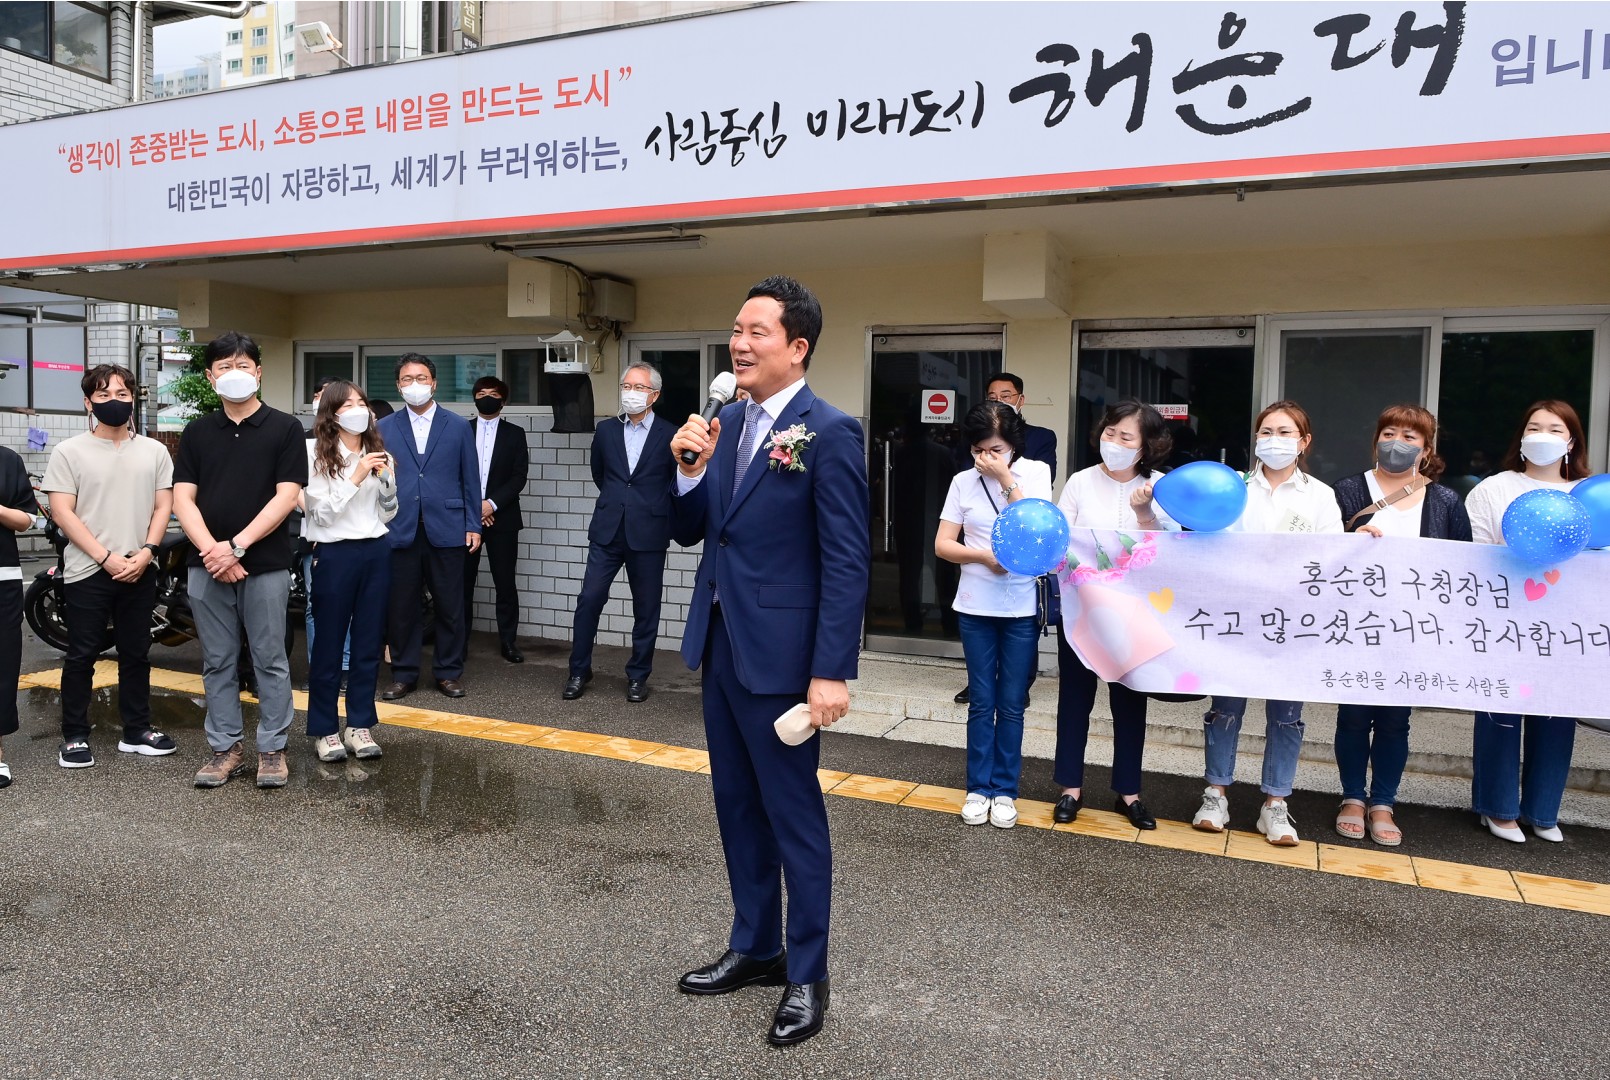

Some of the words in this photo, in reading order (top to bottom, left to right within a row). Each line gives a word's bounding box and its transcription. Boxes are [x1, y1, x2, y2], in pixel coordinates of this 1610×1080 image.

[58, 141, 121, 174] “생각이
[129, 128, 209, 167] 존중받는
[216, 119, 265, 152] 도시,
[273, 106, 367, 145] 소통으로
[375, 93, 451, 133] 내일을
[461, 82, 544, 124] 만드는
[553, 66, 633, 109] 도시”
[168, 173, 271, 213] 대한민국이
[280, 163, 380, 202] 자랑하고,
[390, 150, 468, 190] 세계가
[477, 136, 628, 183] 부러워하는,
[644, 101, 788, 168] 사람중심
[806, 80, 986, 142] 미래도시
[1008, 1, 1468, 137] 해운대
[1491, 28, 1610, 88] 입니
[1299, 561, 1387, 598] 홍순헌
[1401, 569, 1510, 609] 구청장님
[1184, 607, 1245, 641] 수고
[1260, 607, 1455, 647] 많으셨습니다.
[1464, 617, 1610, 657] 감사합니다
[1320, 668, 1387, 691] 홍순헌을
[1394, 670, 1460, 693] 사랑하는
[1465, 675, 1511, 699] 사람들
[66, 742, 89, 751] FILA
